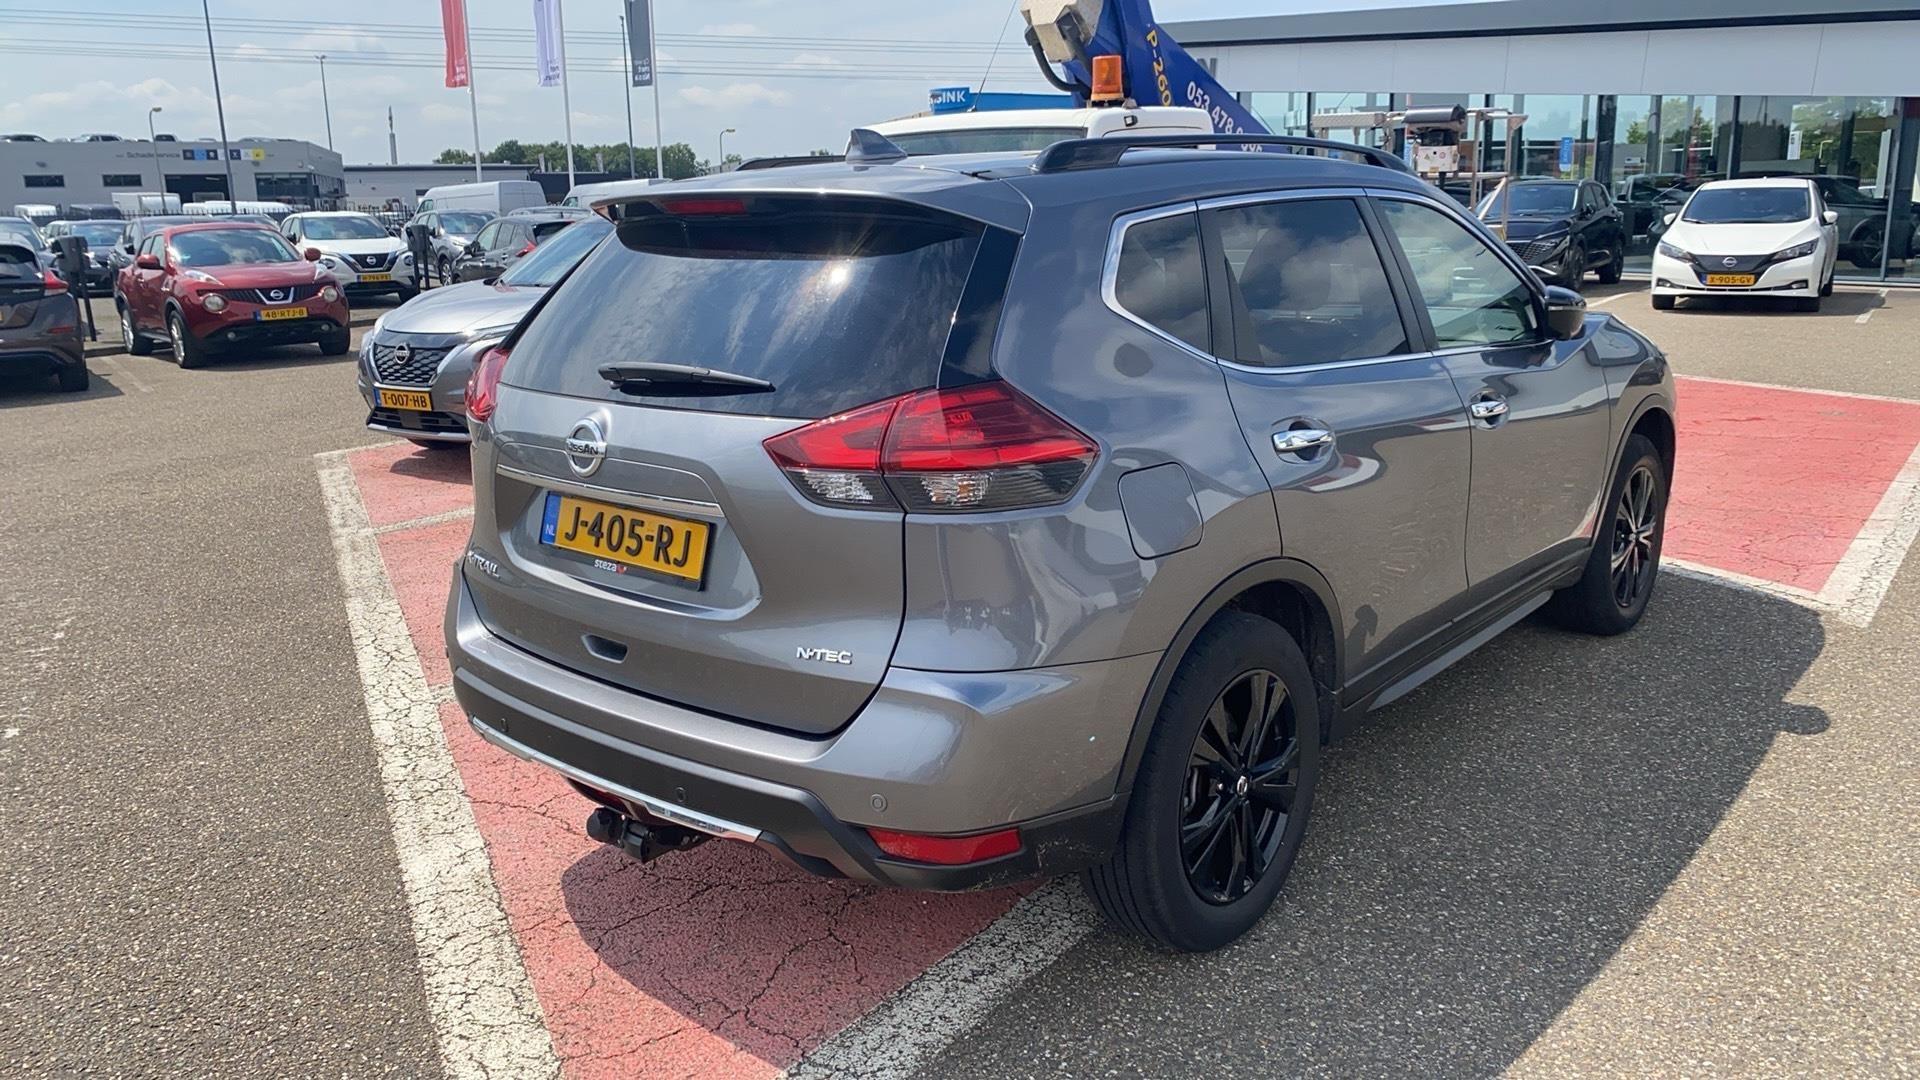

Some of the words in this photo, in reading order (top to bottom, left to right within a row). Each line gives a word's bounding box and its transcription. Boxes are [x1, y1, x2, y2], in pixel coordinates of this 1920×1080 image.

[1146, 29, 1171, 106] P-260
[1187, 81, 1210, 111] 053
[1212, 106, 1234, 134] 478
[381, 392, 428, 408] T-007-HB
[544, 524, 555, 536] NL
[564, 506, 692, 568] J-405-RJ
